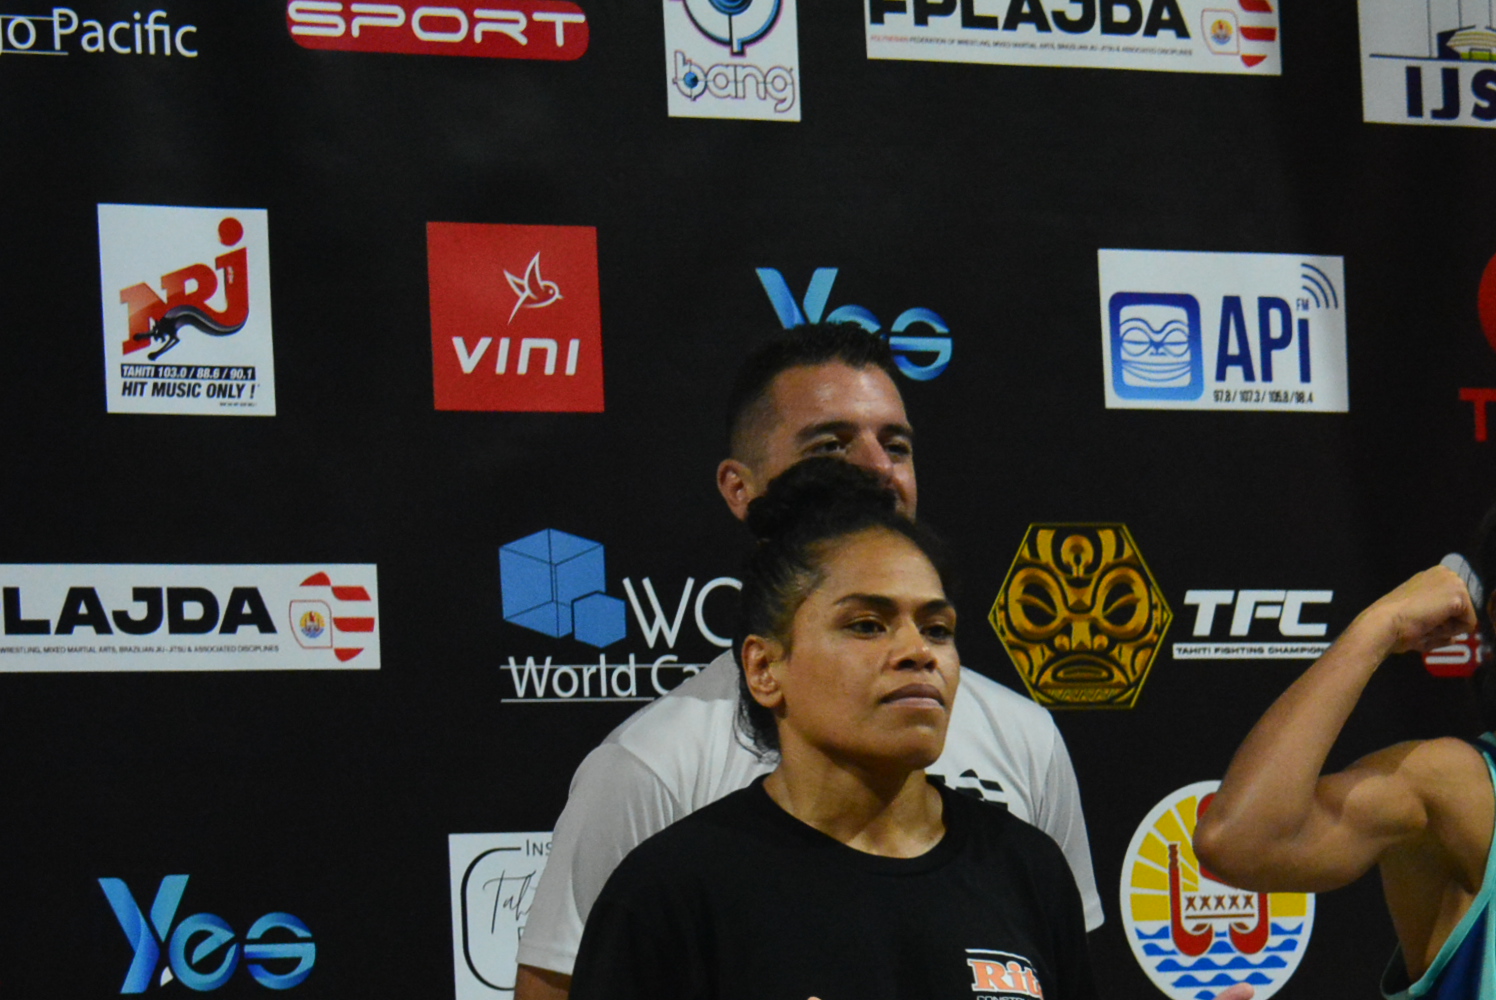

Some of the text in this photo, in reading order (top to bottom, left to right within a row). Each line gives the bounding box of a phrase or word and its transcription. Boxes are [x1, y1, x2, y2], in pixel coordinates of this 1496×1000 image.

[52, 7, 198, 57] Pacific
[288, 0, 586, 48] SPORT
[672, 50, 796, 113] bang
[121, 381, 148, 397] HIT
[151, 382, 202, 398] MUSIC
[206, 383, 246, 399] ONLY
[122, 365, 155, 378] TAHITI
[158, 366, 188, 378] 103.0
[196, 367, 220, 379] 88.6
[230, 368, 252, 380] 90.1
[3, 587, 278, 635] LAJDA
[1184, 589, 1334, 637] TFC
[1176, 647, 1211, 655] TAHITI
[1214, 647, 1265, 655] FIGHTING
[508, 653, 637, 698] World
